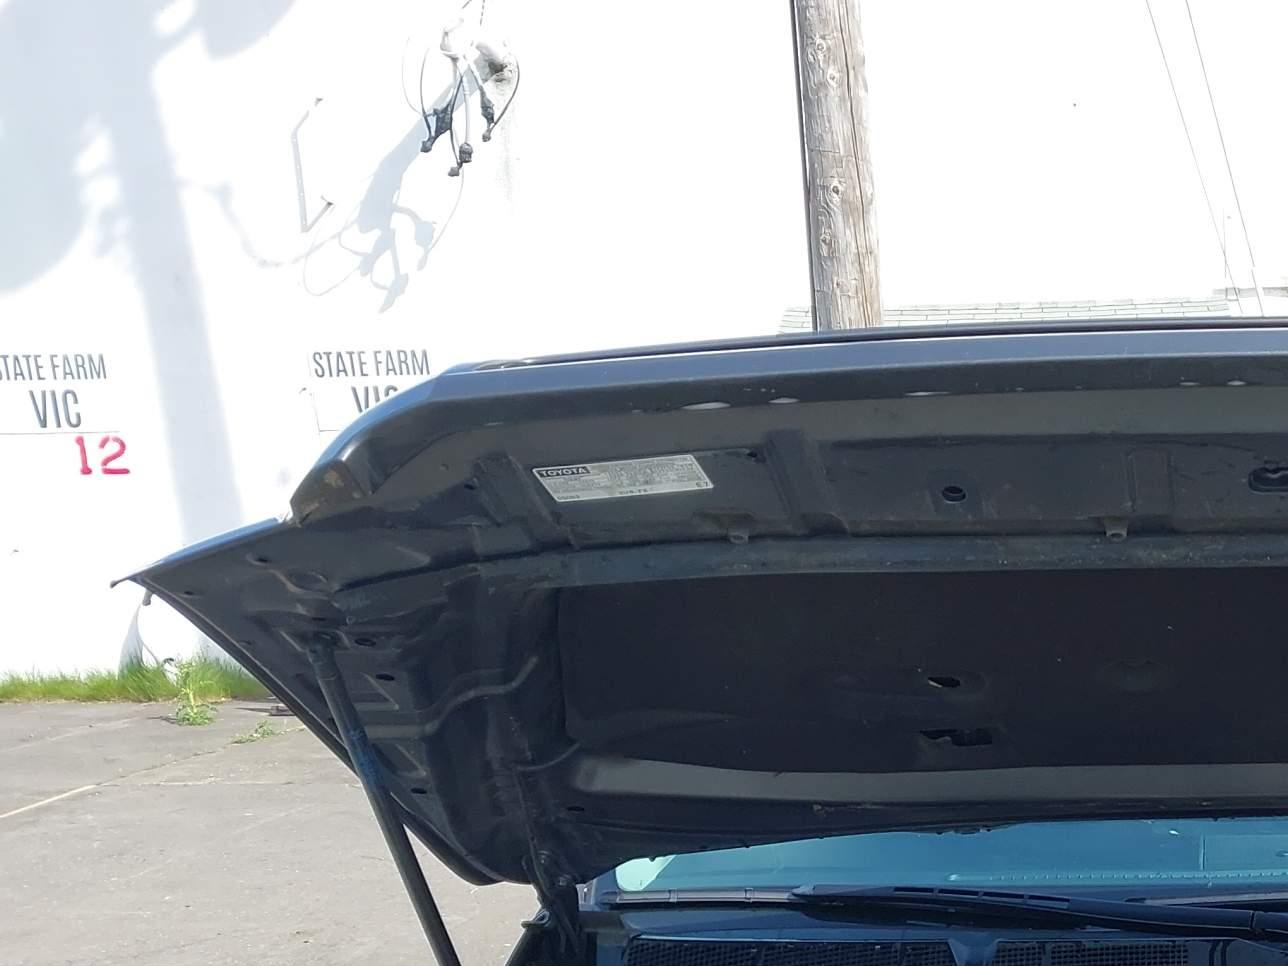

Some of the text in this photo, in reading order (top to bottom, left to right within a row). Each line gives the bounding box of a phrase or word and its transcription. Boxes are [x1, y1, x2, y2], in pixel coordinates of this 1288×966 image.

[0, 353, 107, 381] TATE FARM
[312, 349, 430, 378] STATE FARM
[28, 389, 82, 429] VIC
[75, 435, 131, 475] 12
[540, 467, 588, 477] TOYOTA
